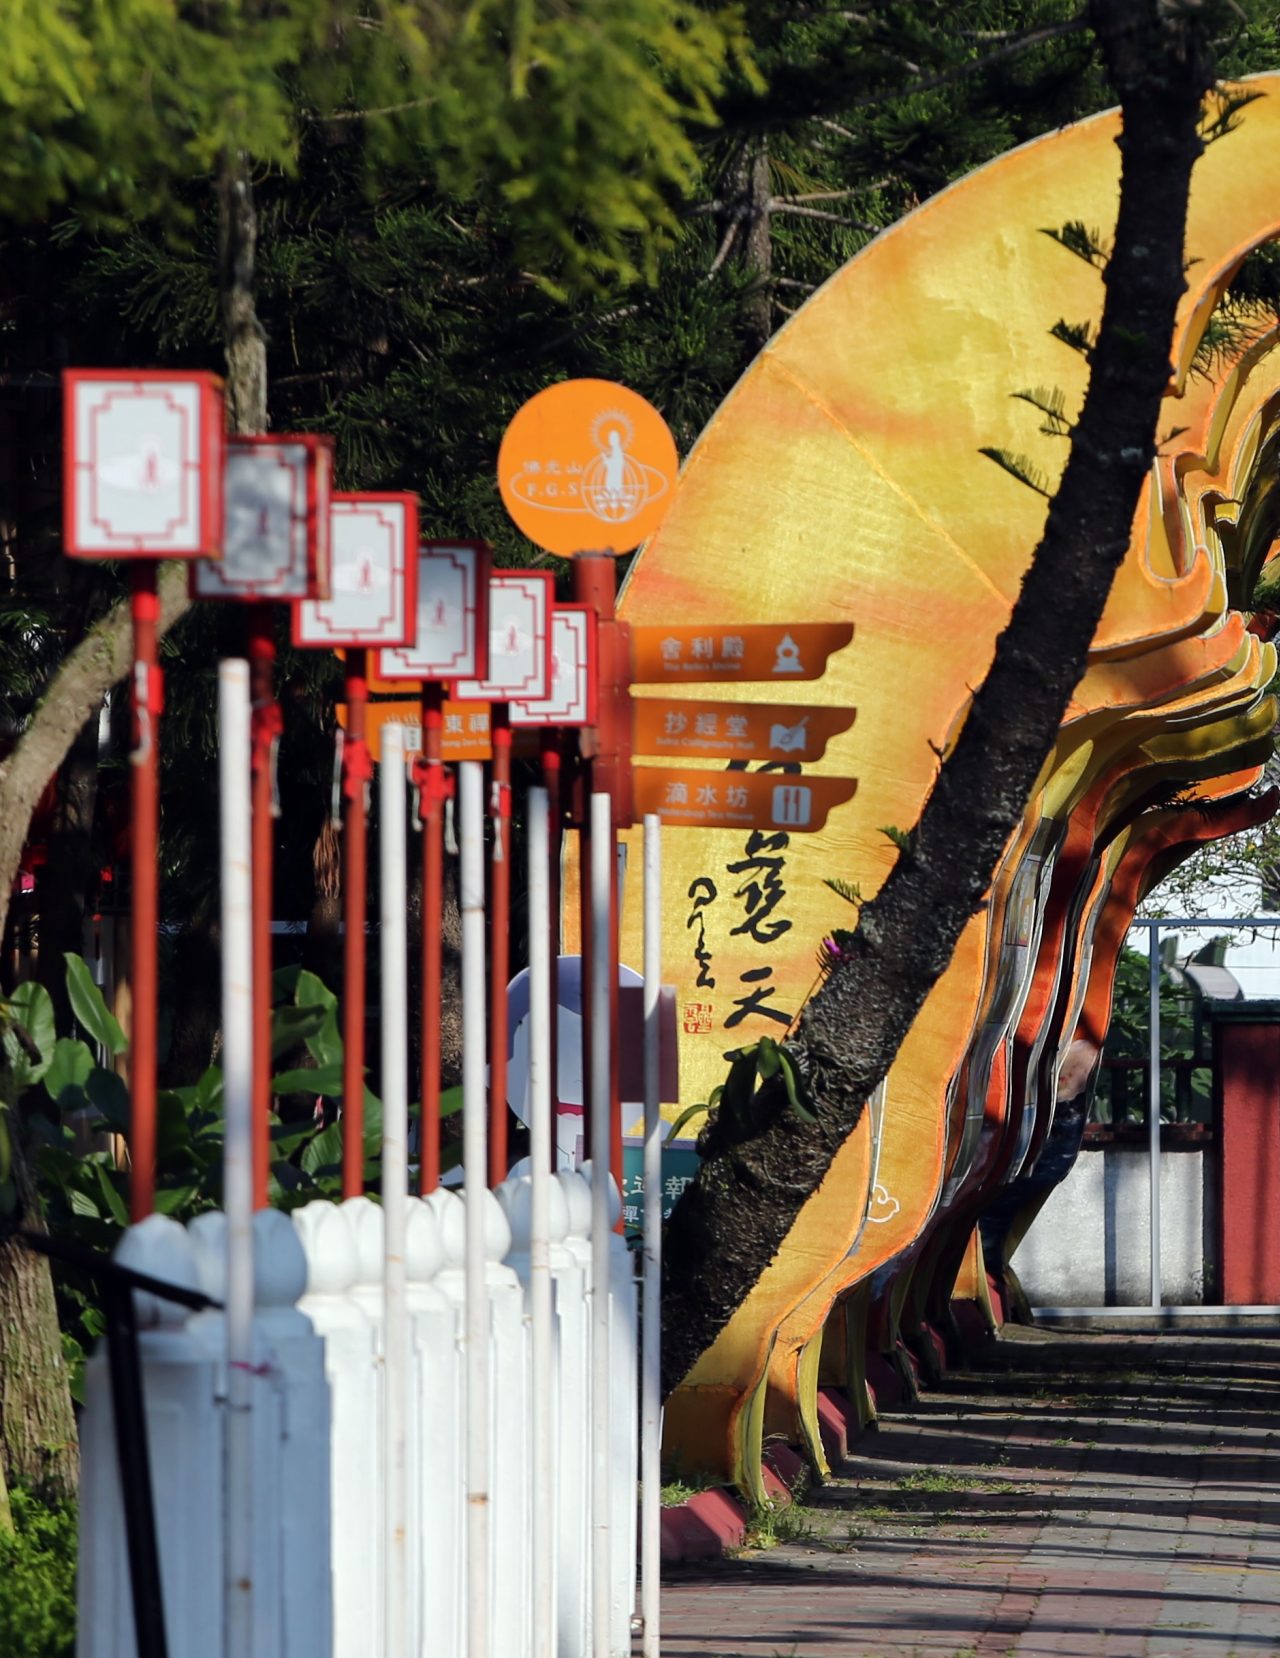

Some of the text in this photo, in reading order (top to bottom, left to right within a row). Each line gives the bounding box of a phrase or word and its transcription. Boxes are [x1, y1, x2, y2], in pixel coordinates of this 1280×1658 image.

[660, 636, 744, 660] 舍利殿
[664, 711, 748, 737] 抄經堂
[665, 782, 748, 807] 滴水坊
